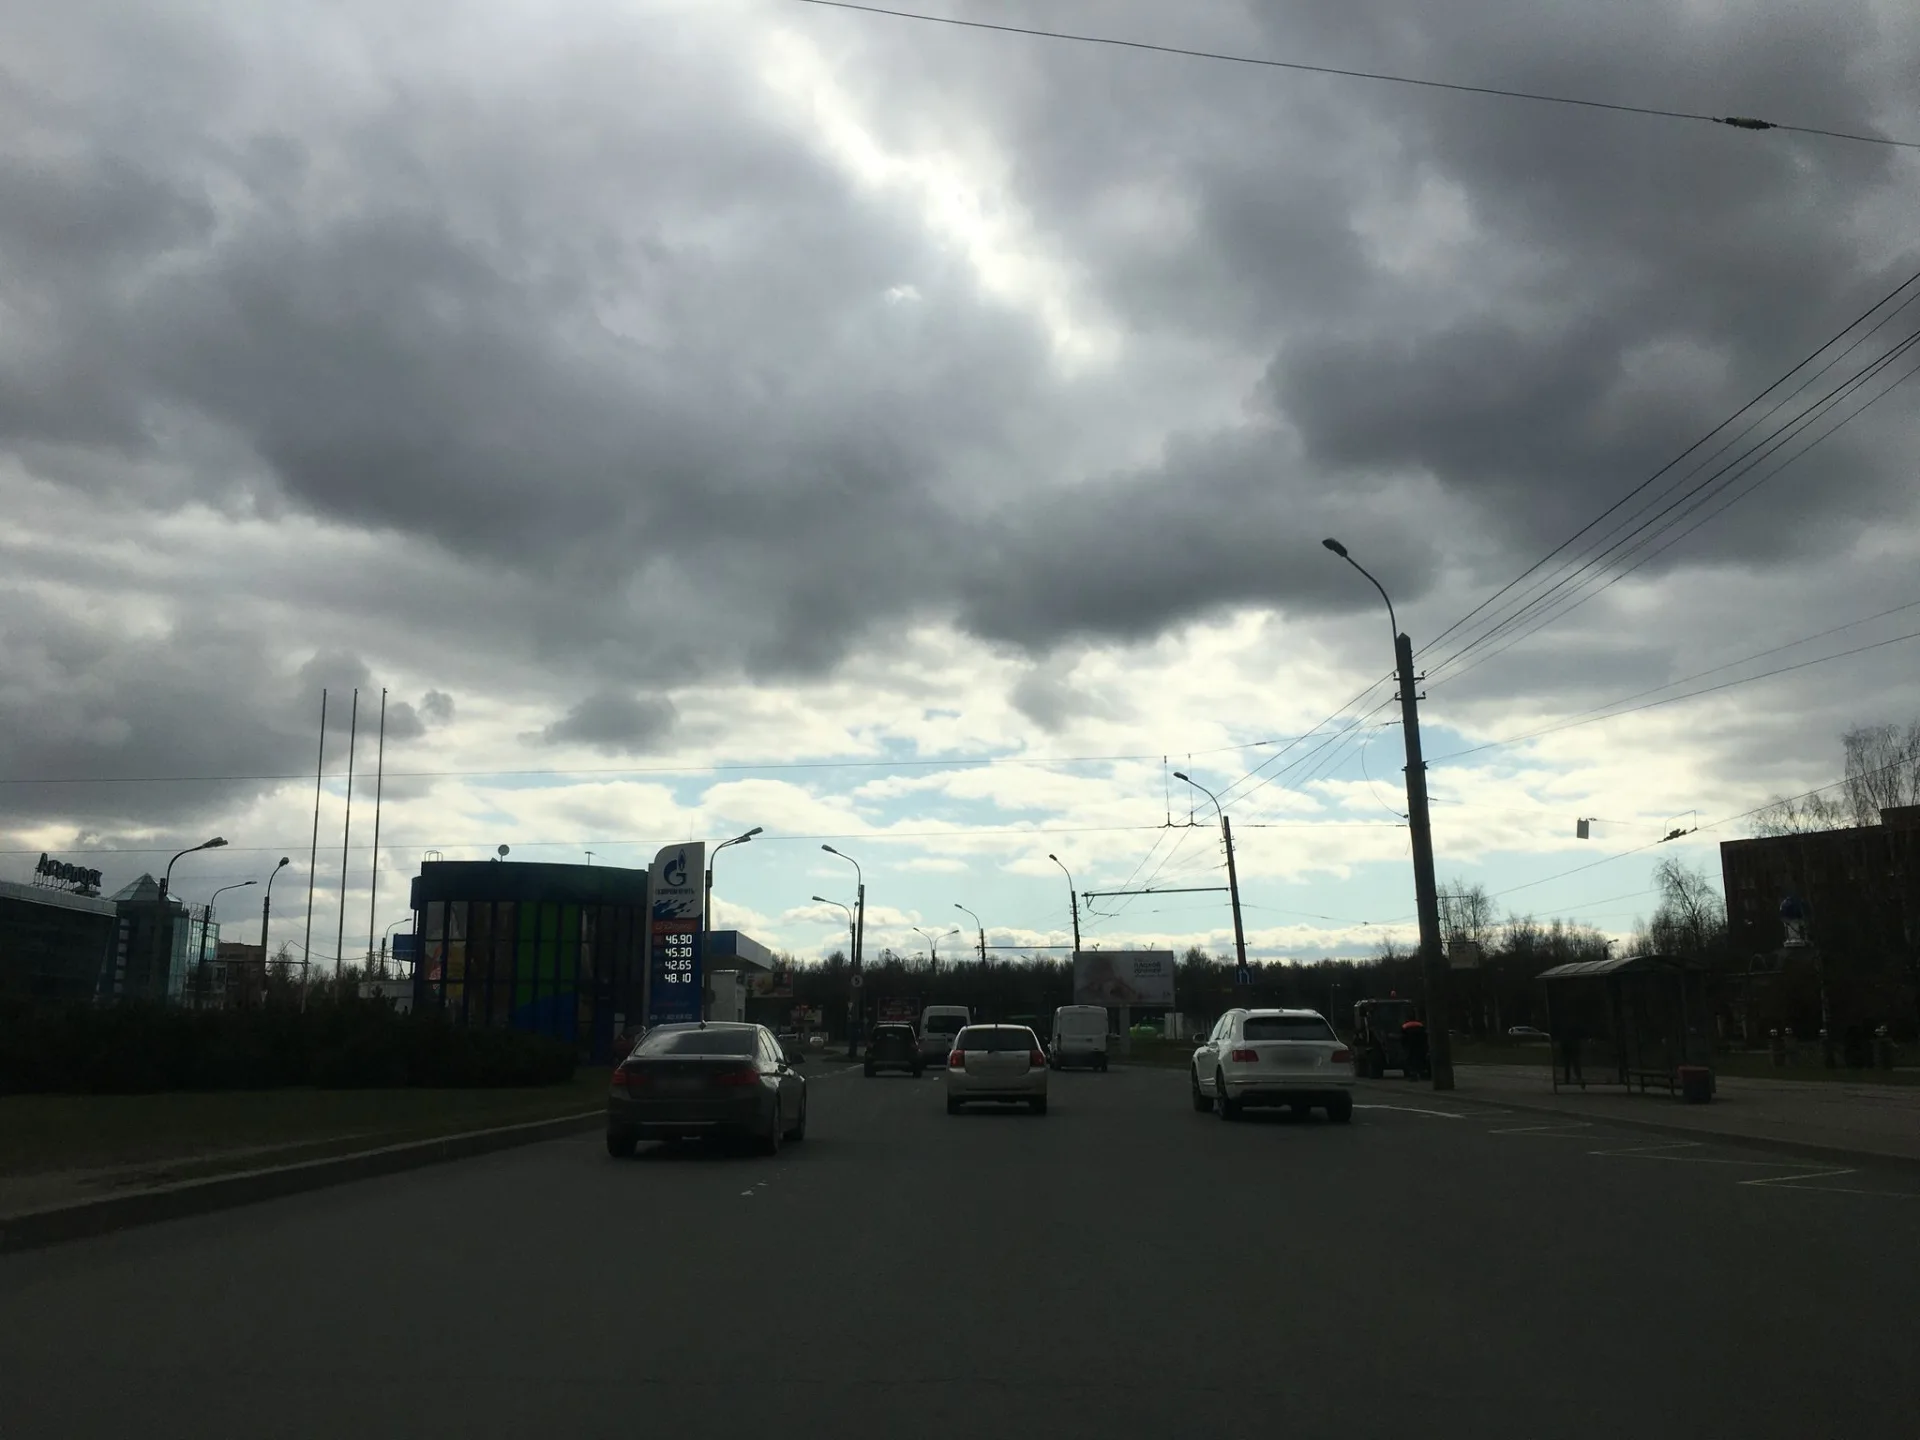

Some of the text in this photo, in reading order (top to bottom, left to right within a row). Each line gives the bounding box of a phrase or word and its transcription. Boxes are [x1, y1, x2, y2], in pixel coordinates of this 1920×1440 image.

[665, 934, 692, 945] 46.90
[665, 947, 692, 957] 45.30
[664, 960, 692, 970] 42.65
[664, 973, 692, 984] 48.10
